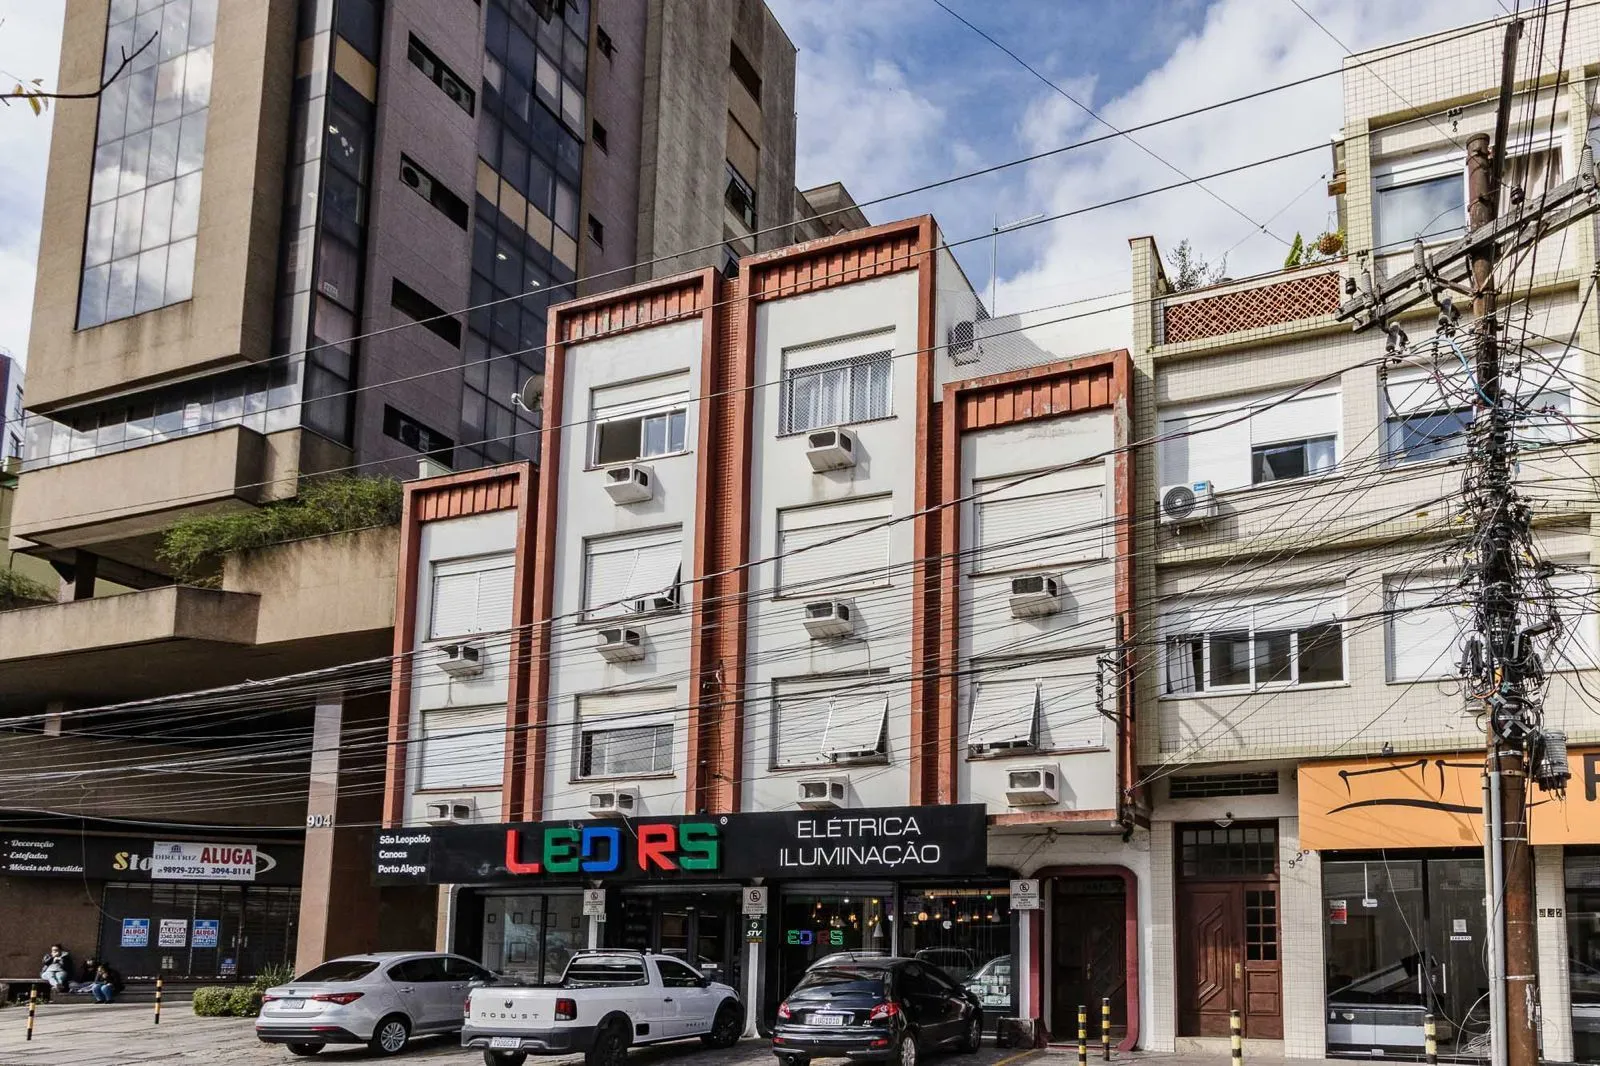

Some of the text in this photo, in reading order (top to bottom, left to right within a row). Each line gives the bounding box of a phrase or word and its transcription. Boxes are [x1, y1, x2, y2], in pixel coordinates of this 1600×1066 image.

[307, 814, 332, 828] 904
[797, 816, 921, 839] ELÉTRICA
[11, 839, 55, 849] Decoração
[379, 834, 431, 845] São Leopoldo
[505, 823, 719, 874] LED RS
[780, 841, 940, 867] ILUMINAÇÃO
[9, 851, 48, 861] Estofados
[200, 846, 254, 865] ALUGA
[379, 850, 408, 859] Canoas
[9, 863, 37, 871] Móveis
[52, 865, 83, 873] medida
[163, 866, 205, 875] 98929-2753
[211, 867, 251, 876] 3094-8114
[378, 864, 426, 876] Porto Alegre
[481, 1011, 539, 1019] ROBUST
